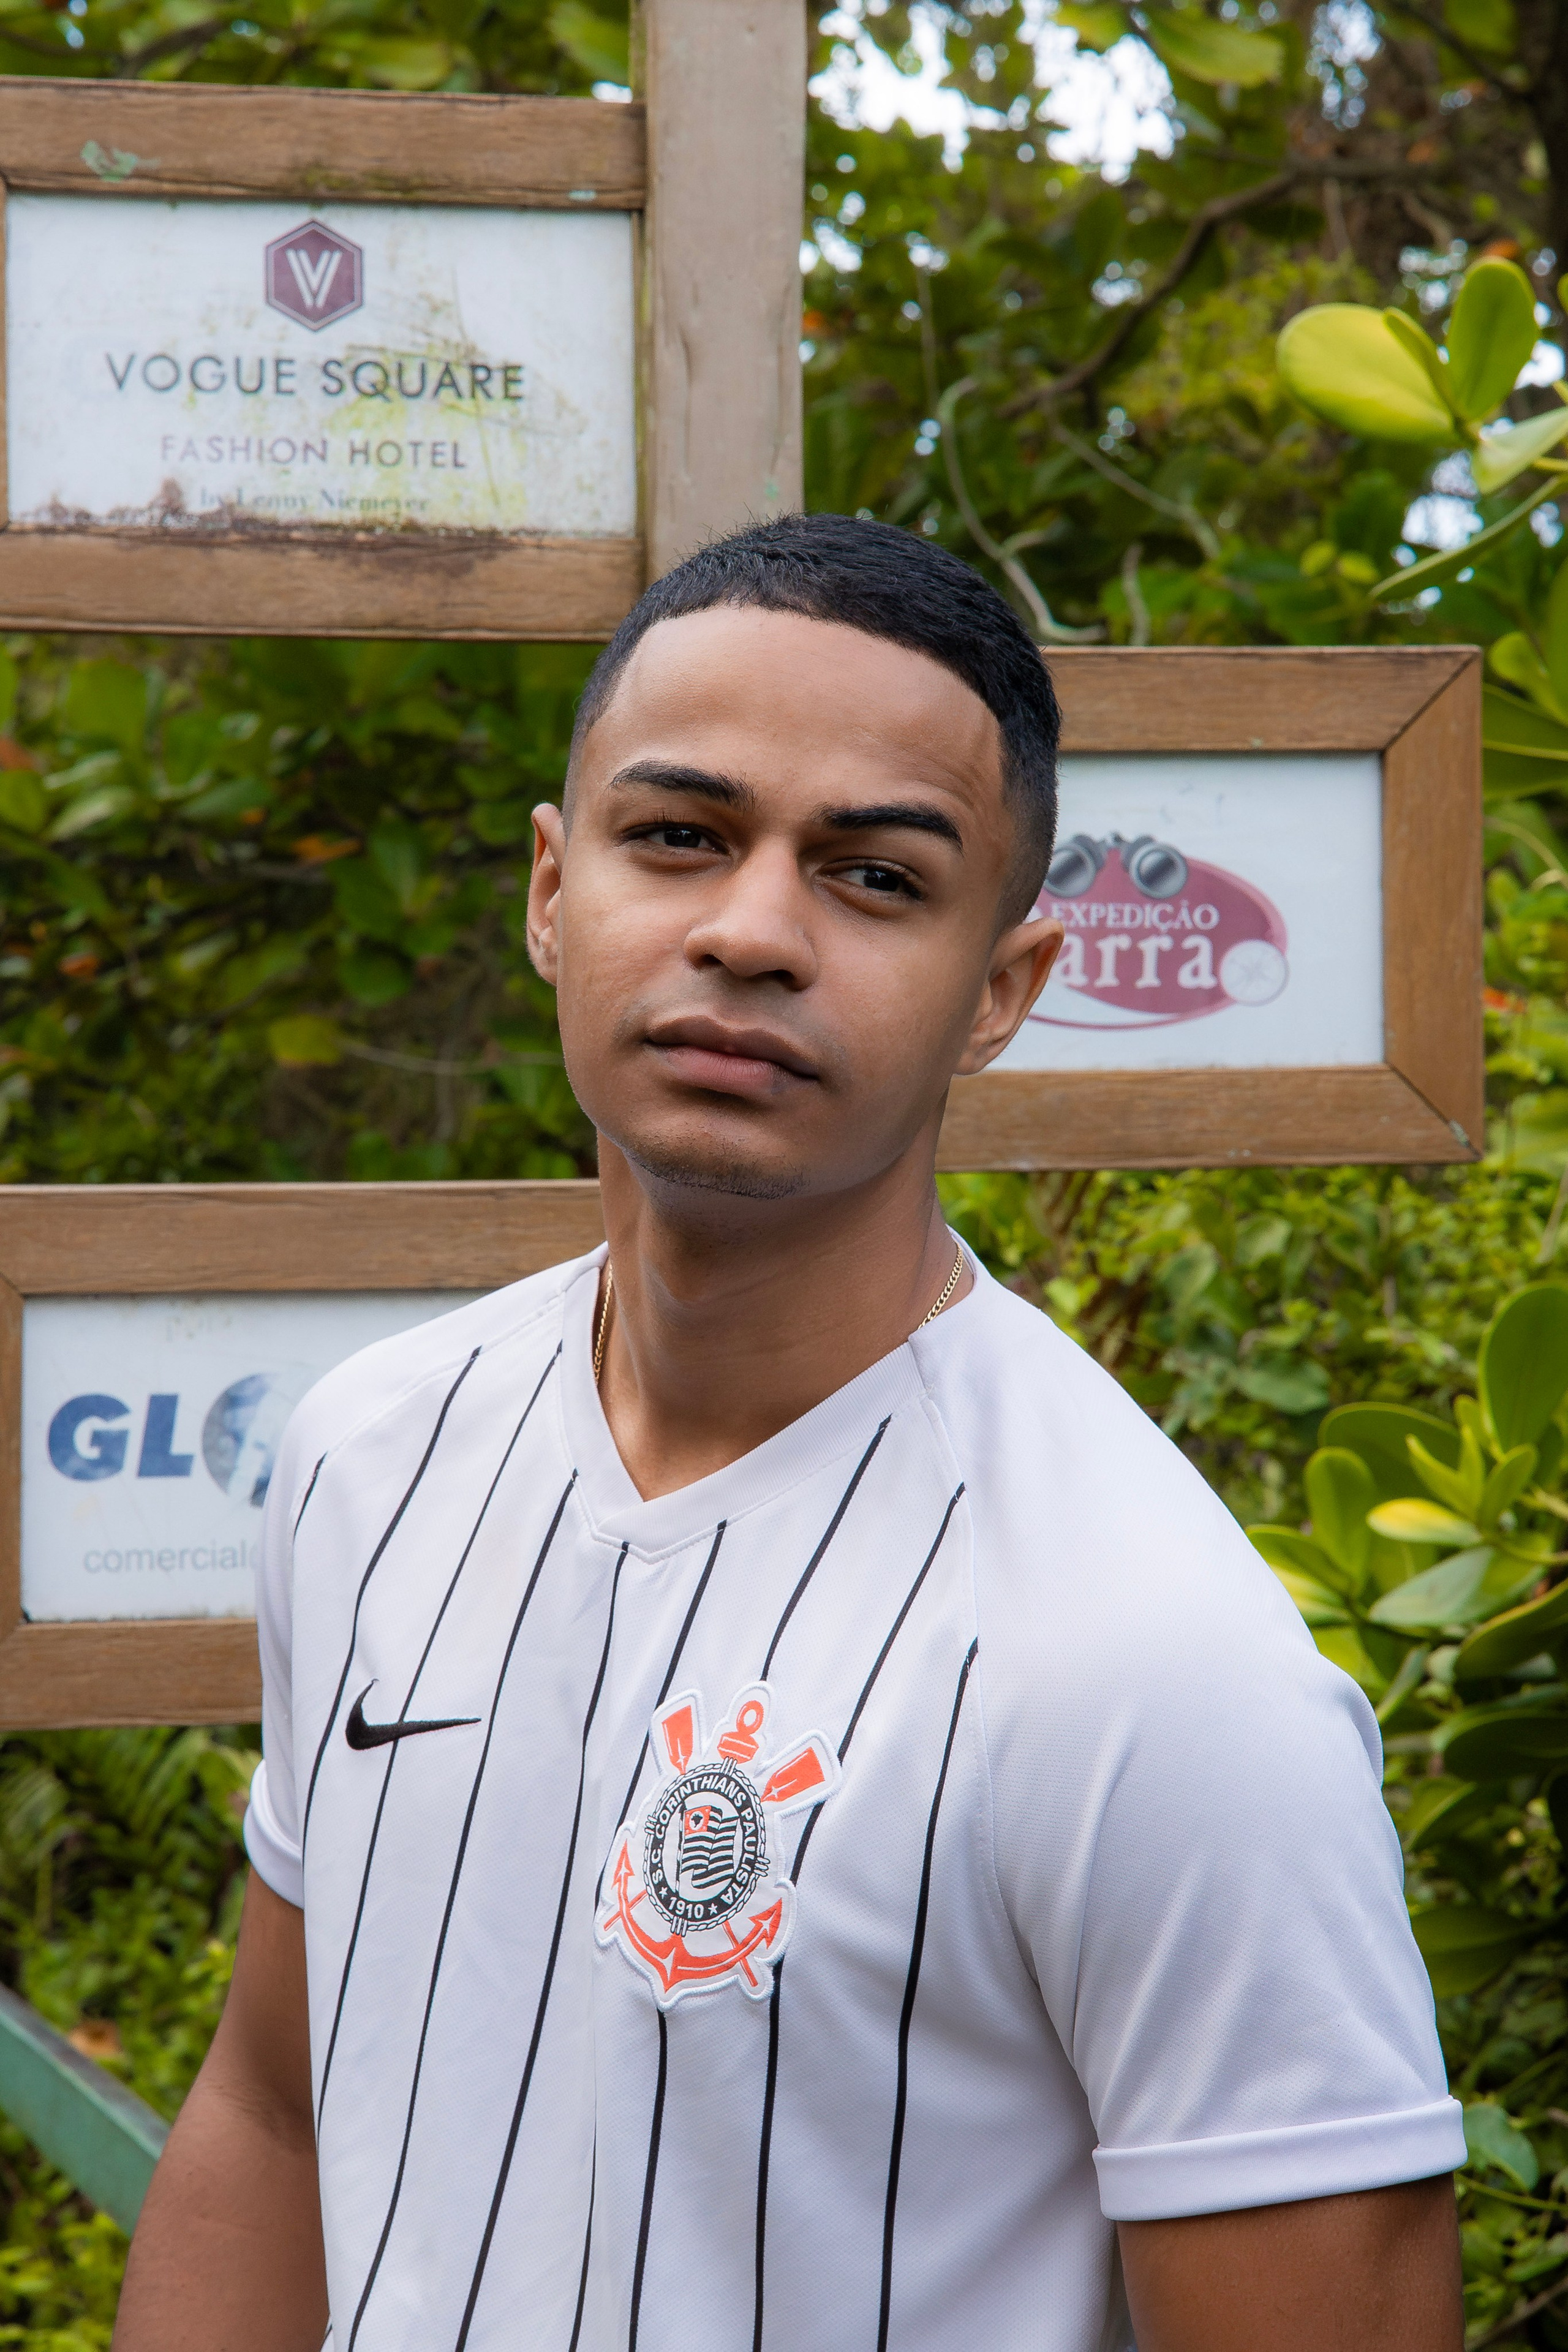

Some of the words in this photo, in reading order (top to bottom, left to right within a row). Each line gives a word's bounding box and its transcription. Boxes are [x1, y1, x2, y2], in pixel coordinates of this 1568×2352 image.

[105, 353, 298, 396] VOGUE
[320, 358, 525, 402] SQUARE
[160, 434, 328, 464] FASHION
[349, 439, 467, 469] HOTEL
[1051, 899, 1221, 933] EXPEDIÇÃO
[1049, 933, 1219, 989] arra
[655, 1775, 747, 1839] CORINTHIANS
[720, 1807, 757, 1905] PAULISTA
[668, 1896, 704, 1920] 1910
